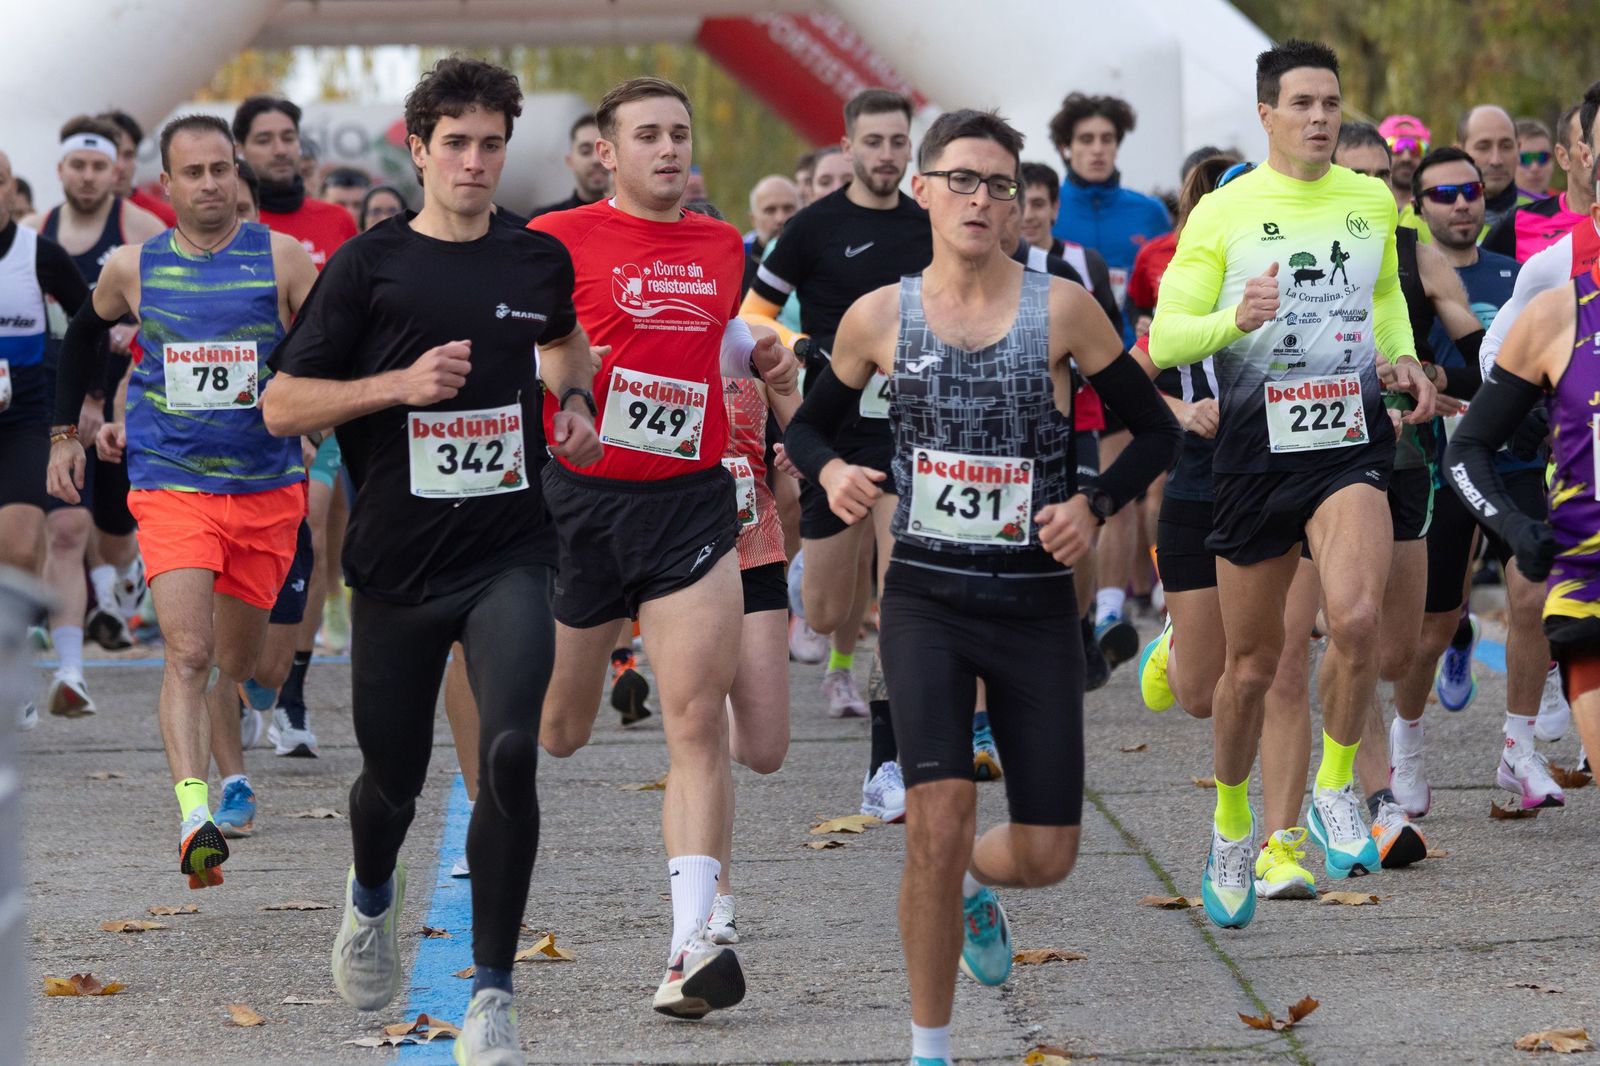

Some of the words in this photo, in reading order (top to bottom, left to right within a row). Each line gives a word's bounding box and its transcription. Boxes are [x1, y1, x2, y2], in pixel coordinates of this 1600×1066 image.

[653, 260, 686, 278] ¡Corre
[687, 262, 703, 278] sin
[647, 278, 717, 296] resistencias!
[1285, 288, 1297, 298] La
[1299, 292, 1344, 302] Corralina,
[167, 346, 255, 364] bedunia
[193, 367, 229, 392] 78
[612, 372, 705, 408] bedunia
[1268, 379, 1360, 403] bedunia
[412, 413, 520, 439] bedunia
[629, 401, 686, 437] 949
[1290, 401, 1346, 432] 222
[437, 440, 504, 475] 342
[917, 458, 1029, 484] bedunia
[1450, 462, 1486, 511] TERREX
[936, 485, 1002, 521] 431
